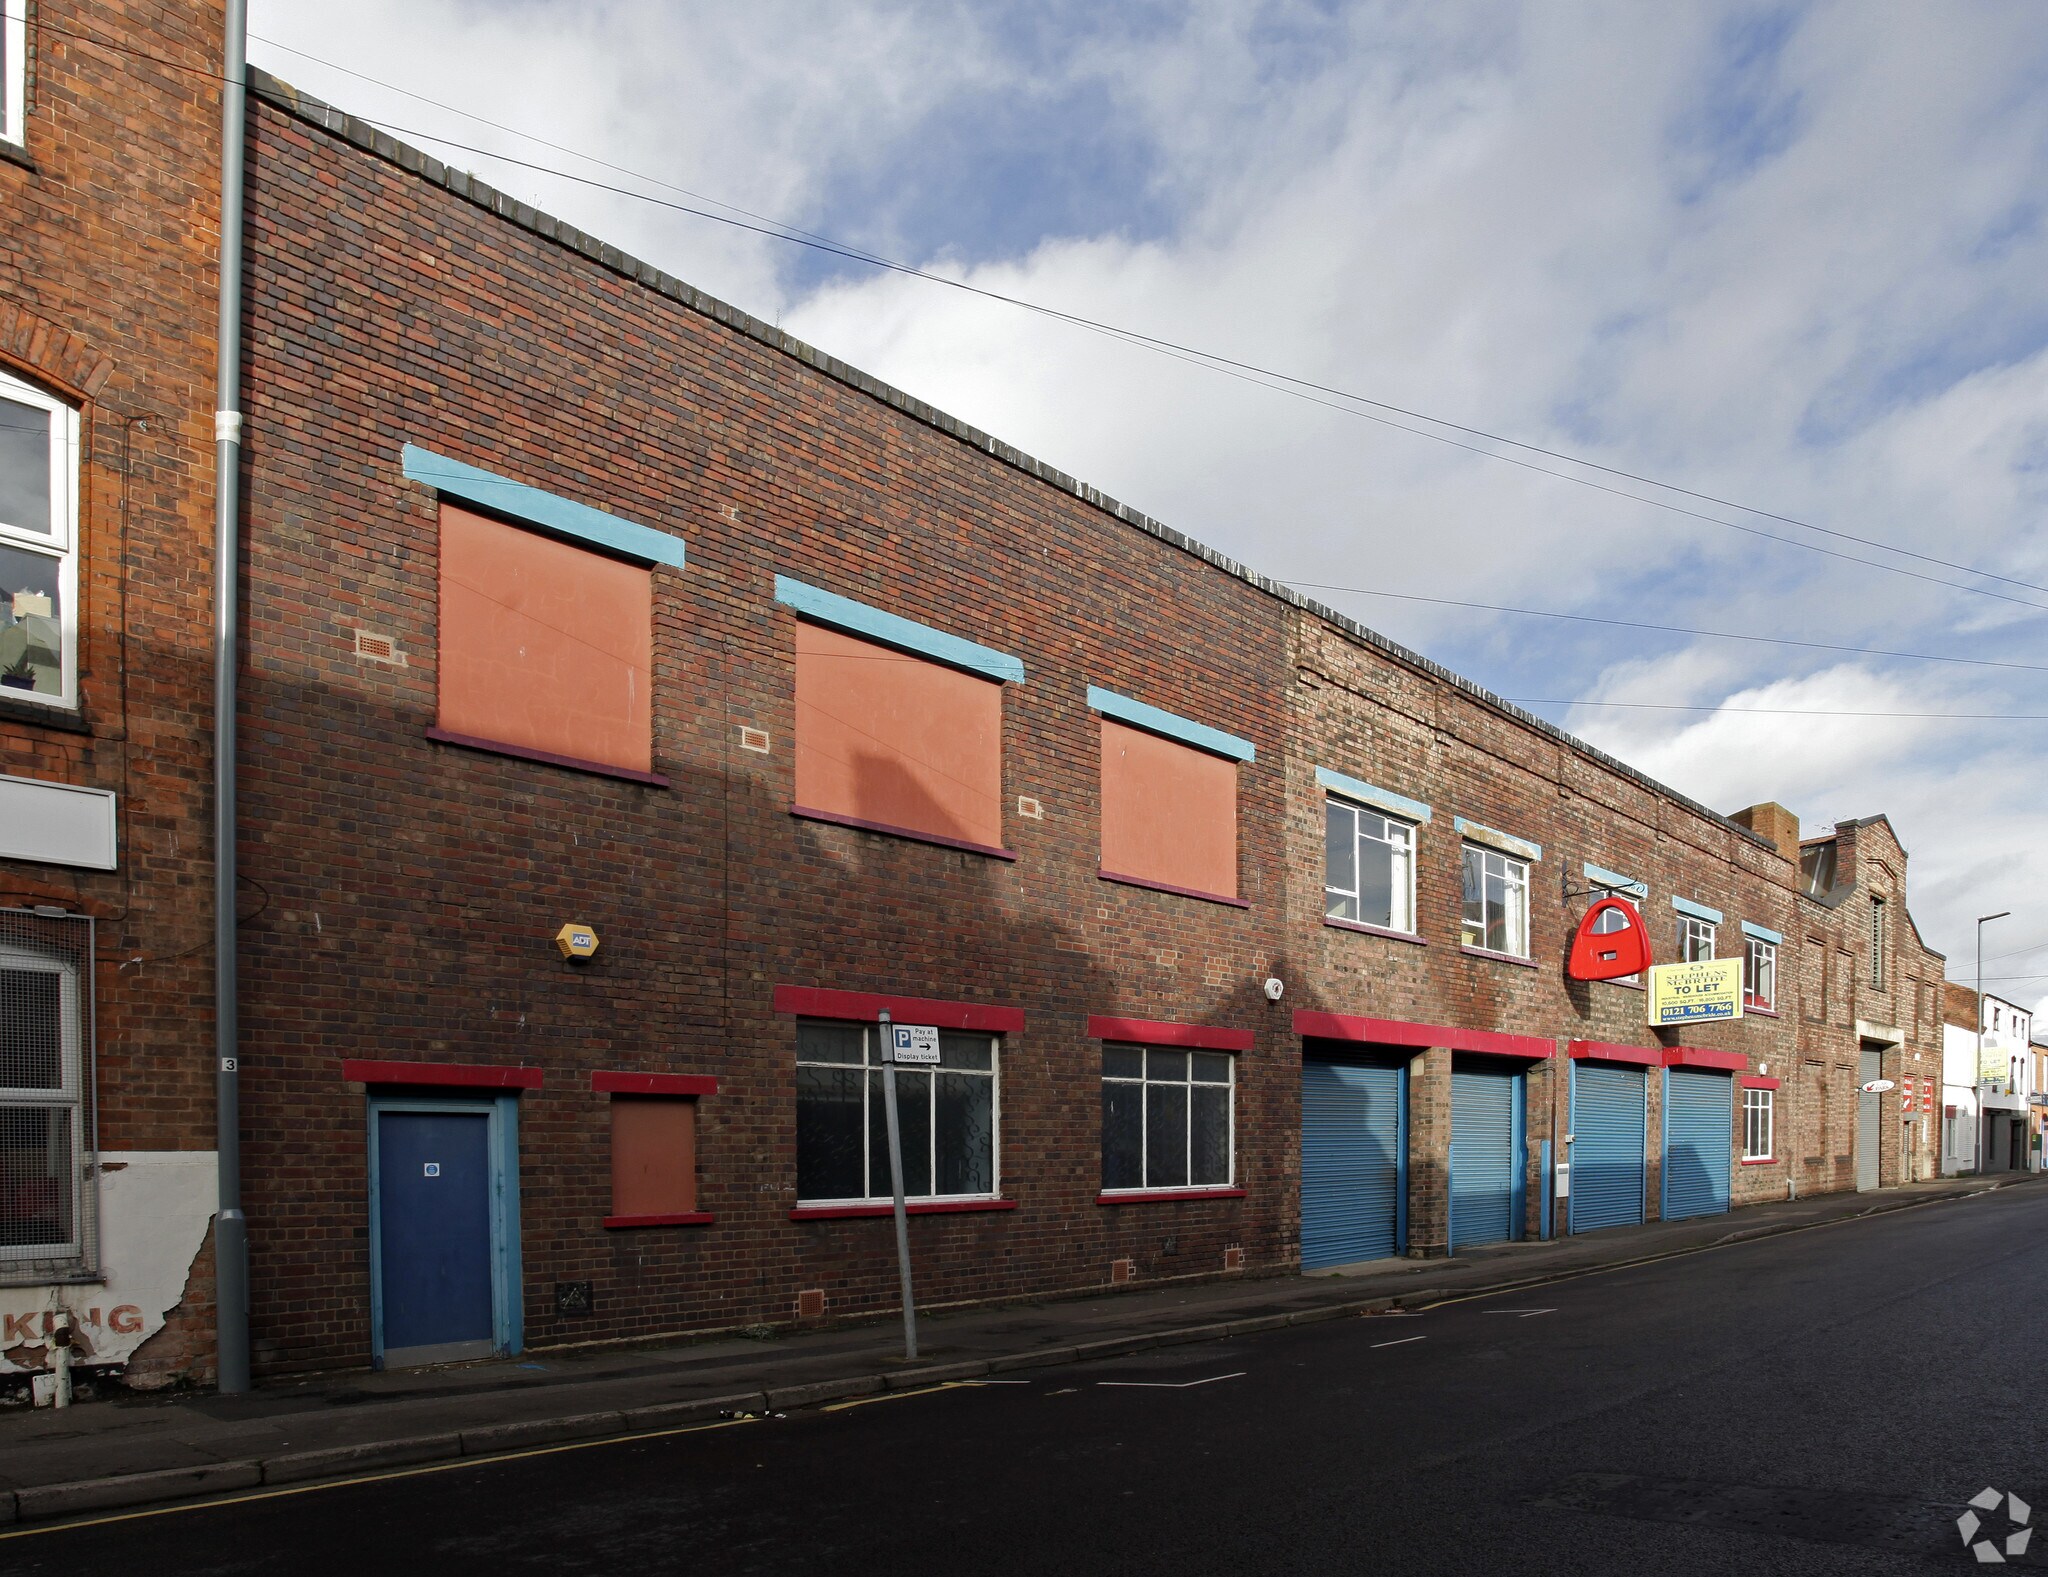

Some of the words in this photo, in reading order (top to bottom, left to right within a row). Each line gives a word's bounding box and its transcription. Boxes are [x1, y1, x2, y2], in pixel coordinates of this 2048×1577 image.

[573, 936, 591, 946] ADT
[1666, 970, 1728, 980] STEPHENS
[1674, 986, 1691, 995] TO
[1696, 983, 1719, 993] LET
[1662, 1007, 1685, 1016] 0121
[1688, 1005, 1706, 1014] 706
[1709, 1002, 1732, 1012] 7766
[915, 1028, 926, 1036] Pay
[898, 1031, 909, 1046] P
[226, 1059, 235, 1070] 3
